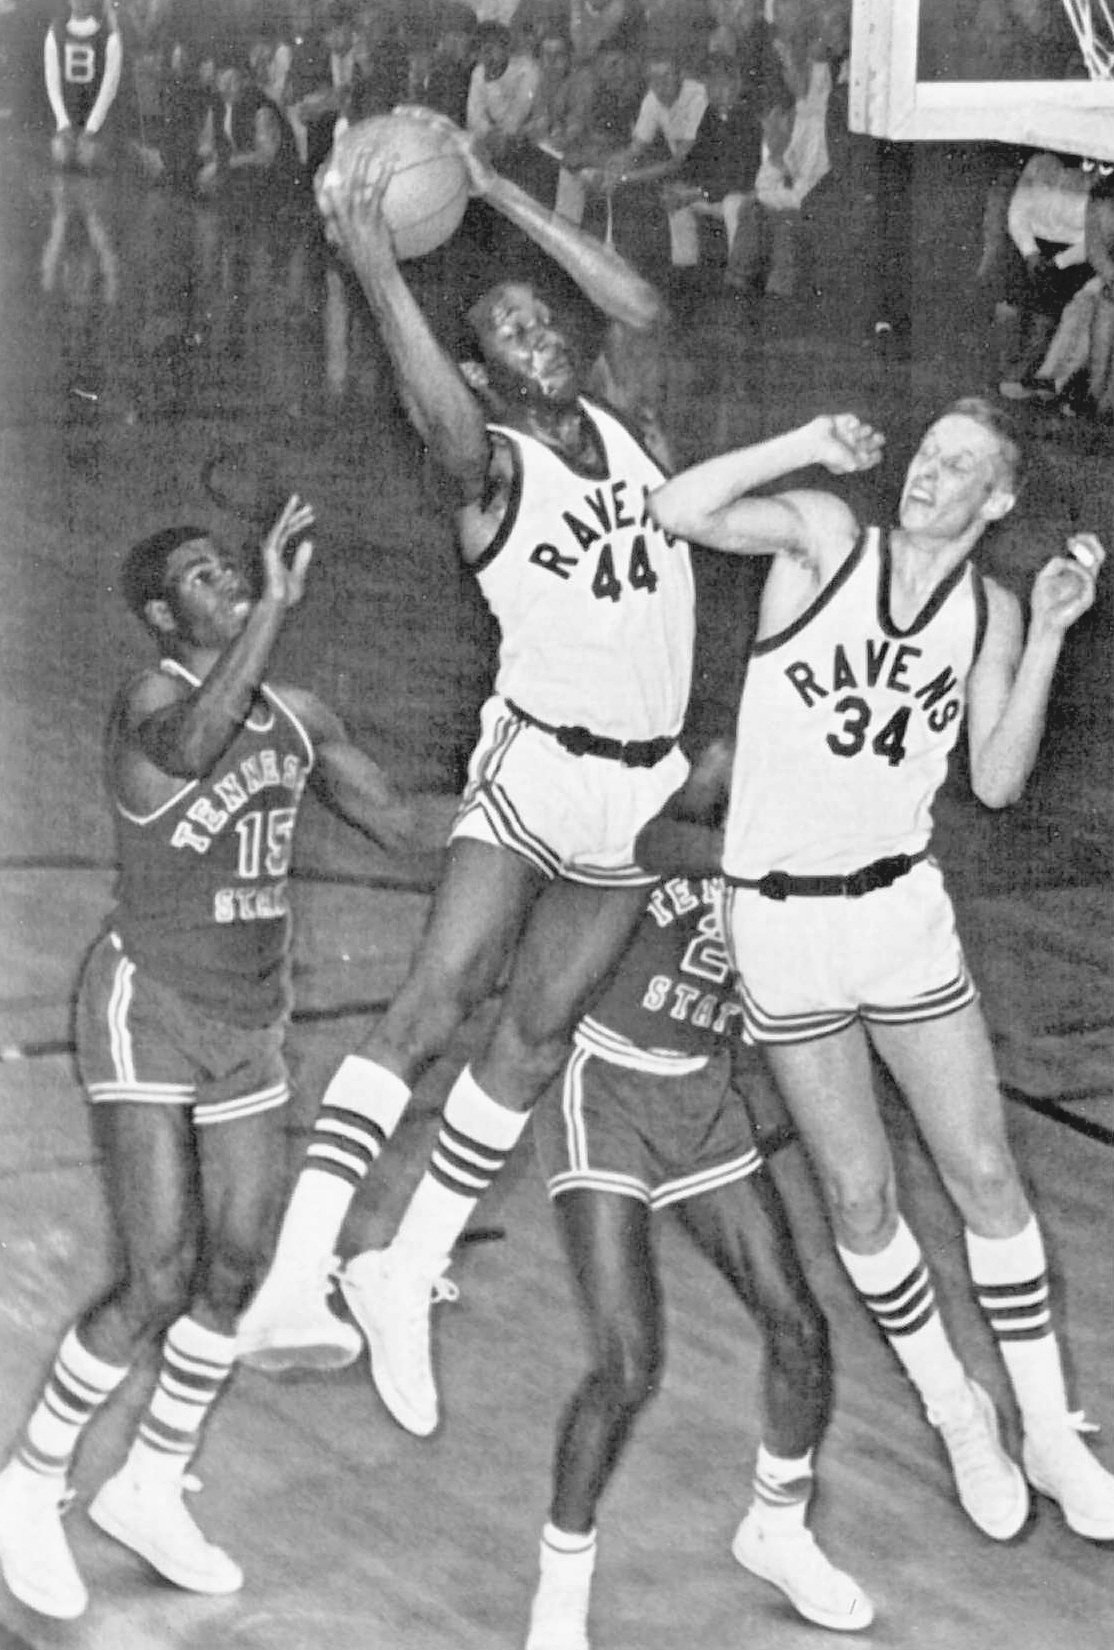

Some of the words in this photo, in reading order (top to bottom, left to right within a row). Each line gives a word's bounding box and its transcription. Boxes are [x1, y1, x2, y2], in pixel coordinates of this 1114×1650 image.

[592, 534, 658, 603] 44
[784, 639, 960, 733] RAVENS
[826, 695, 912, 767] 34
[234, 807, 297, 879] 15
